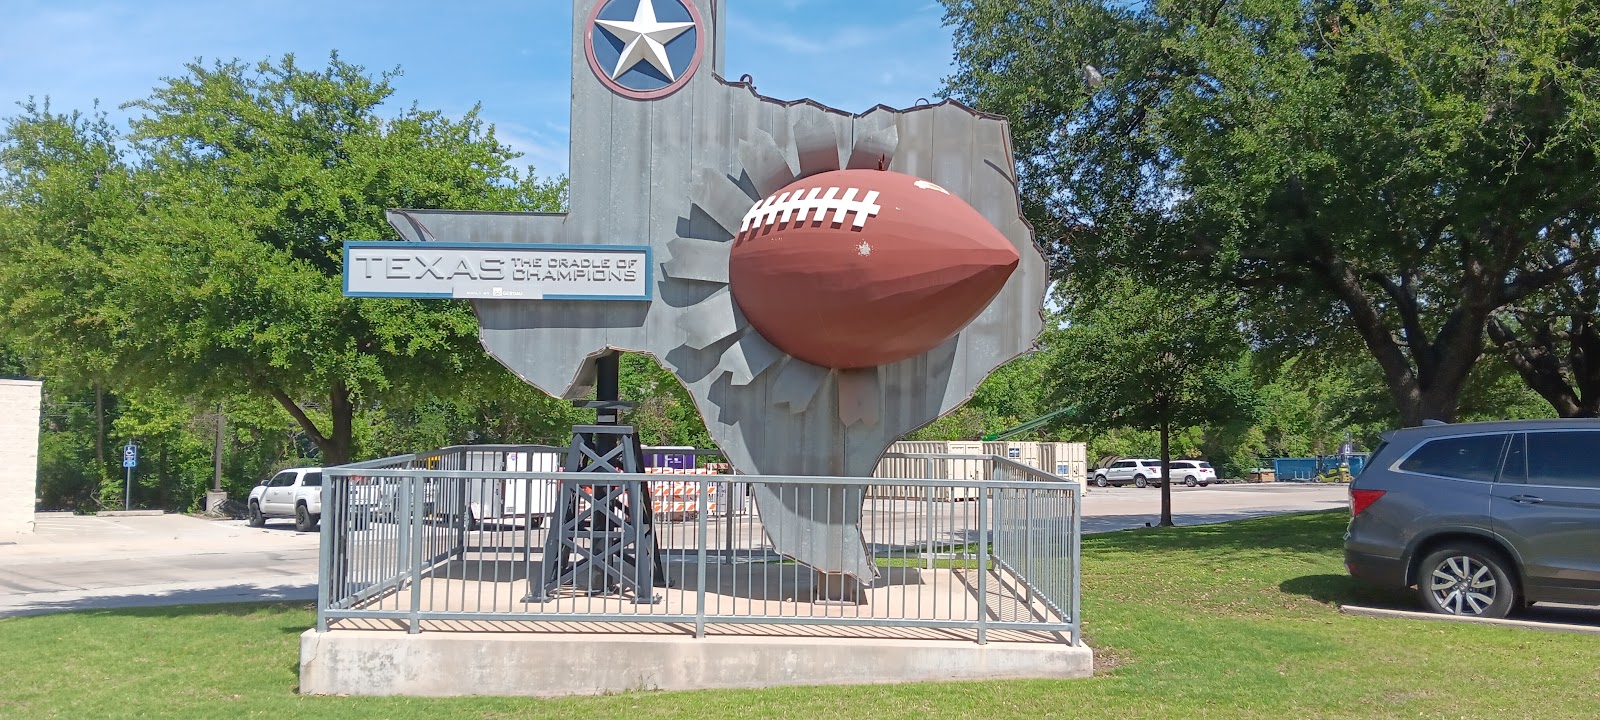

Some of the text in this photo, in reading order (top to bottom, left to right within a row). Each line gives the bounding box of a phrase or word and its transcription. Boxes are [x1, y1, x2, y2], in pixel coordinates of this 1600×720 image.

[355, 256, 505, 281] TEXAS
[511, 257, 638, 269] THE CRADLE OF
[512, 269, 637, 282] CHAMPIONS
